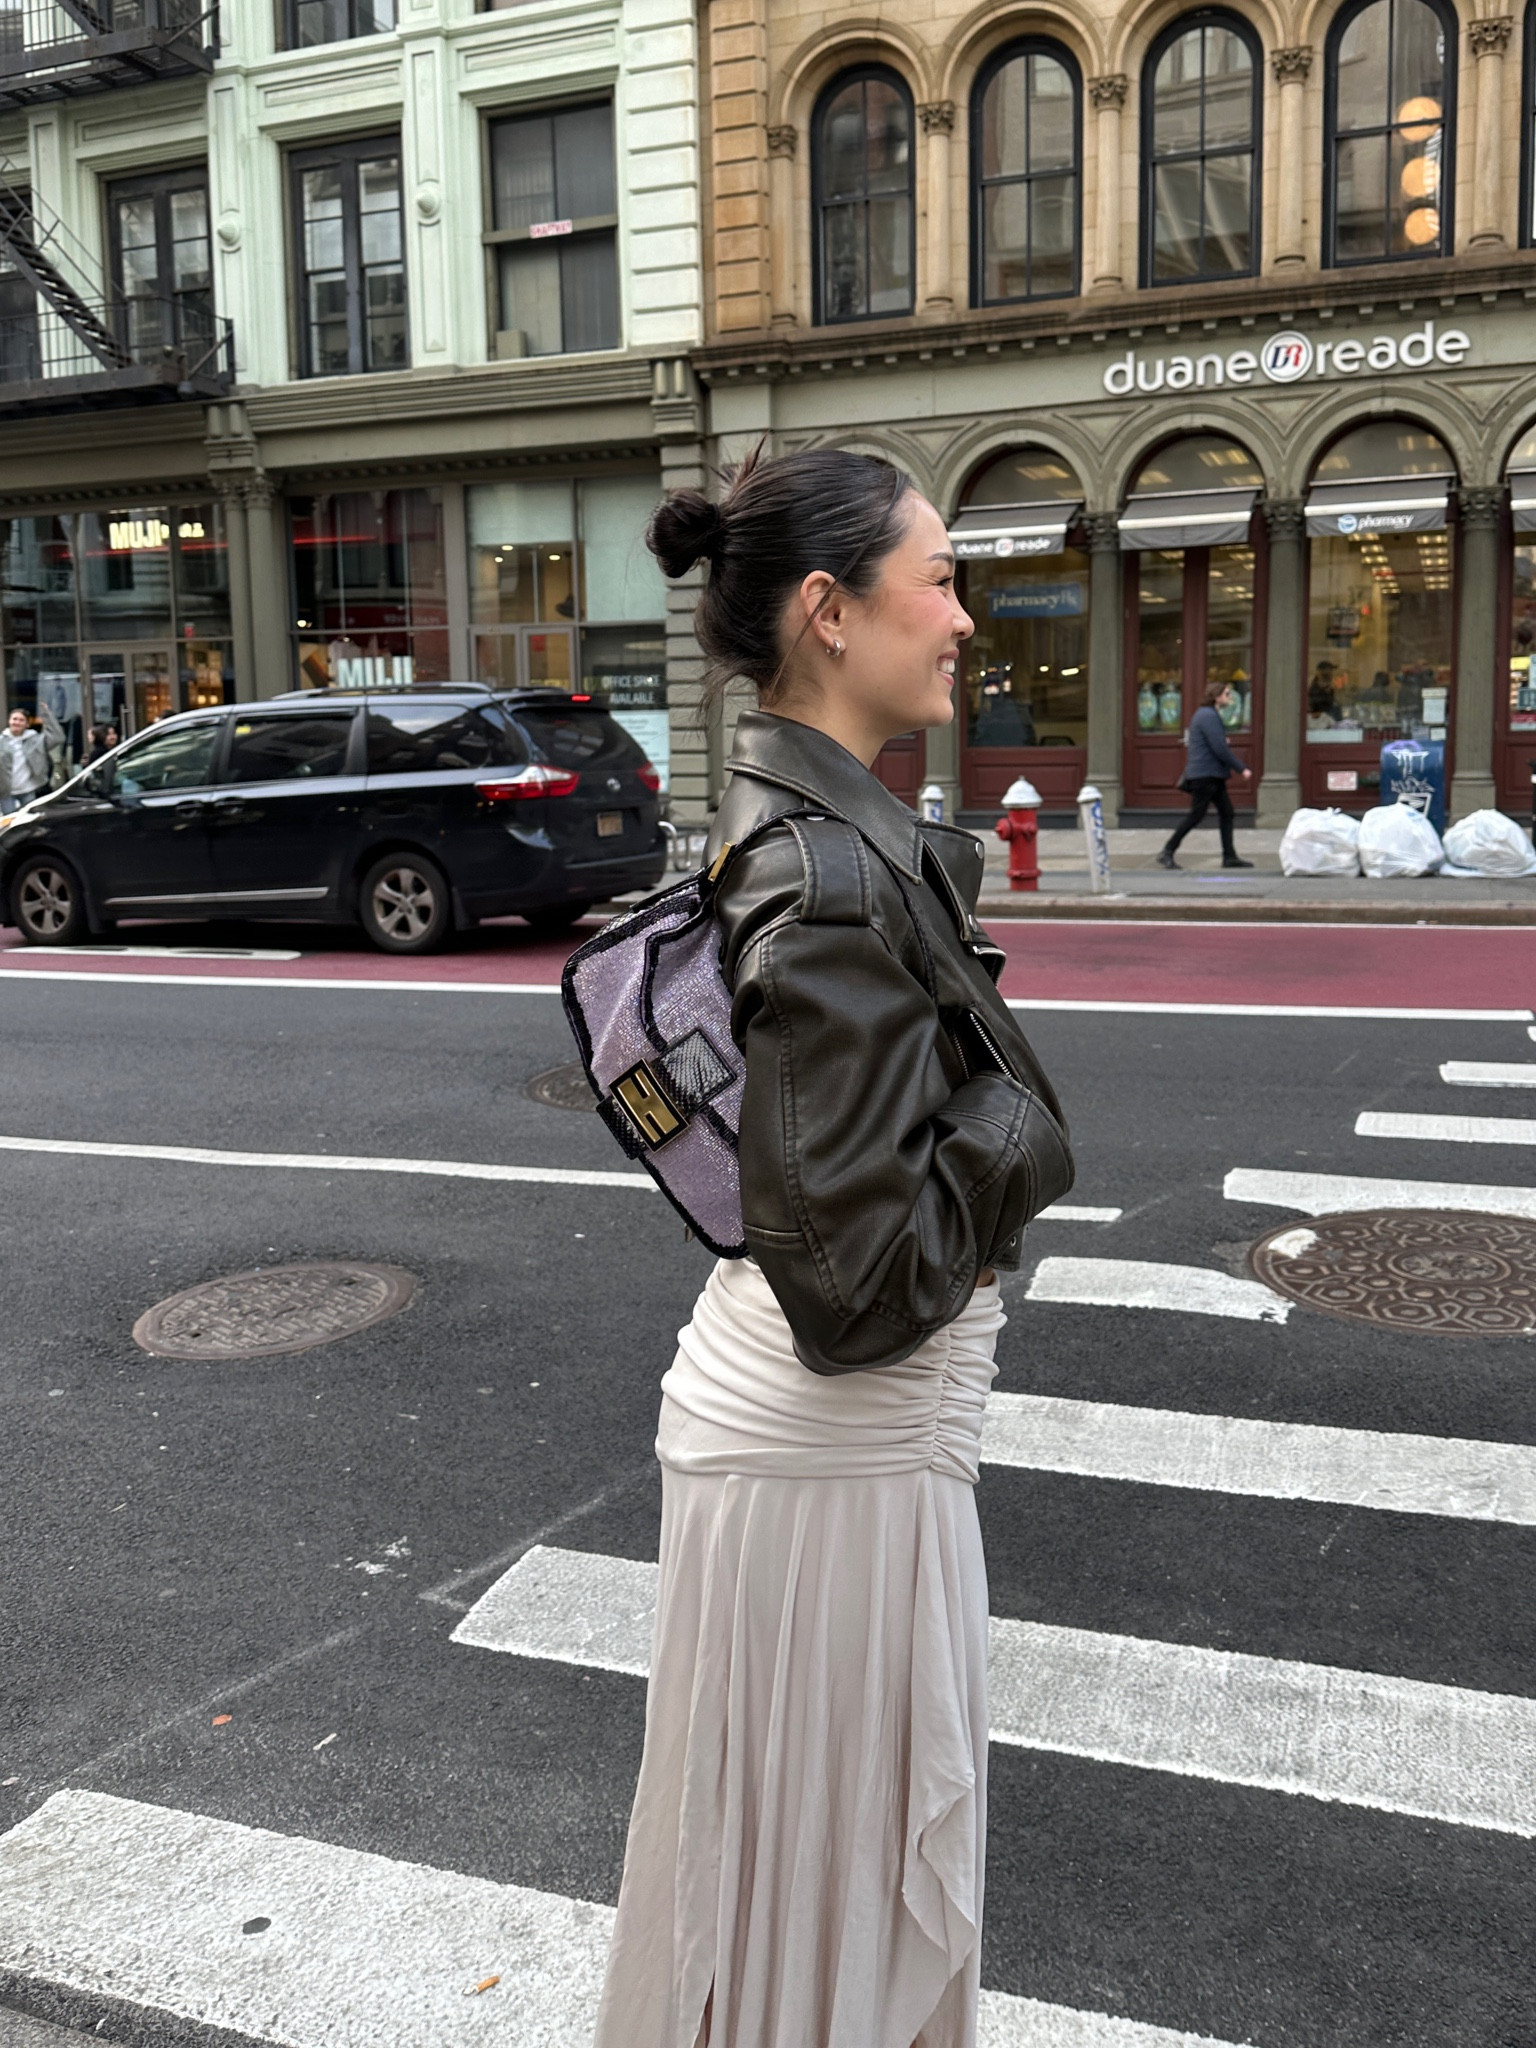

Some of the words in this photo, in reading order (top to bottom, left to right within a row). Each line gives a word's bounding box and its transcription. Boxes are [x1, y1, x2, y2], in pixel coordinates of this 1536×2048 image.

[1103, 351, 1258, 395] duane
[1315, 320, 1472, 376] reade
[1357, 514, 1414, 531] pharmacy
[109, 519, 162, 550] MUJI
[956, 542, 993, 555] duane
[1015, 537, 1051, 551] reade
[601, 676, 632, 690] OFFICE
[609, 692, 656, 704] AVAILABLE
